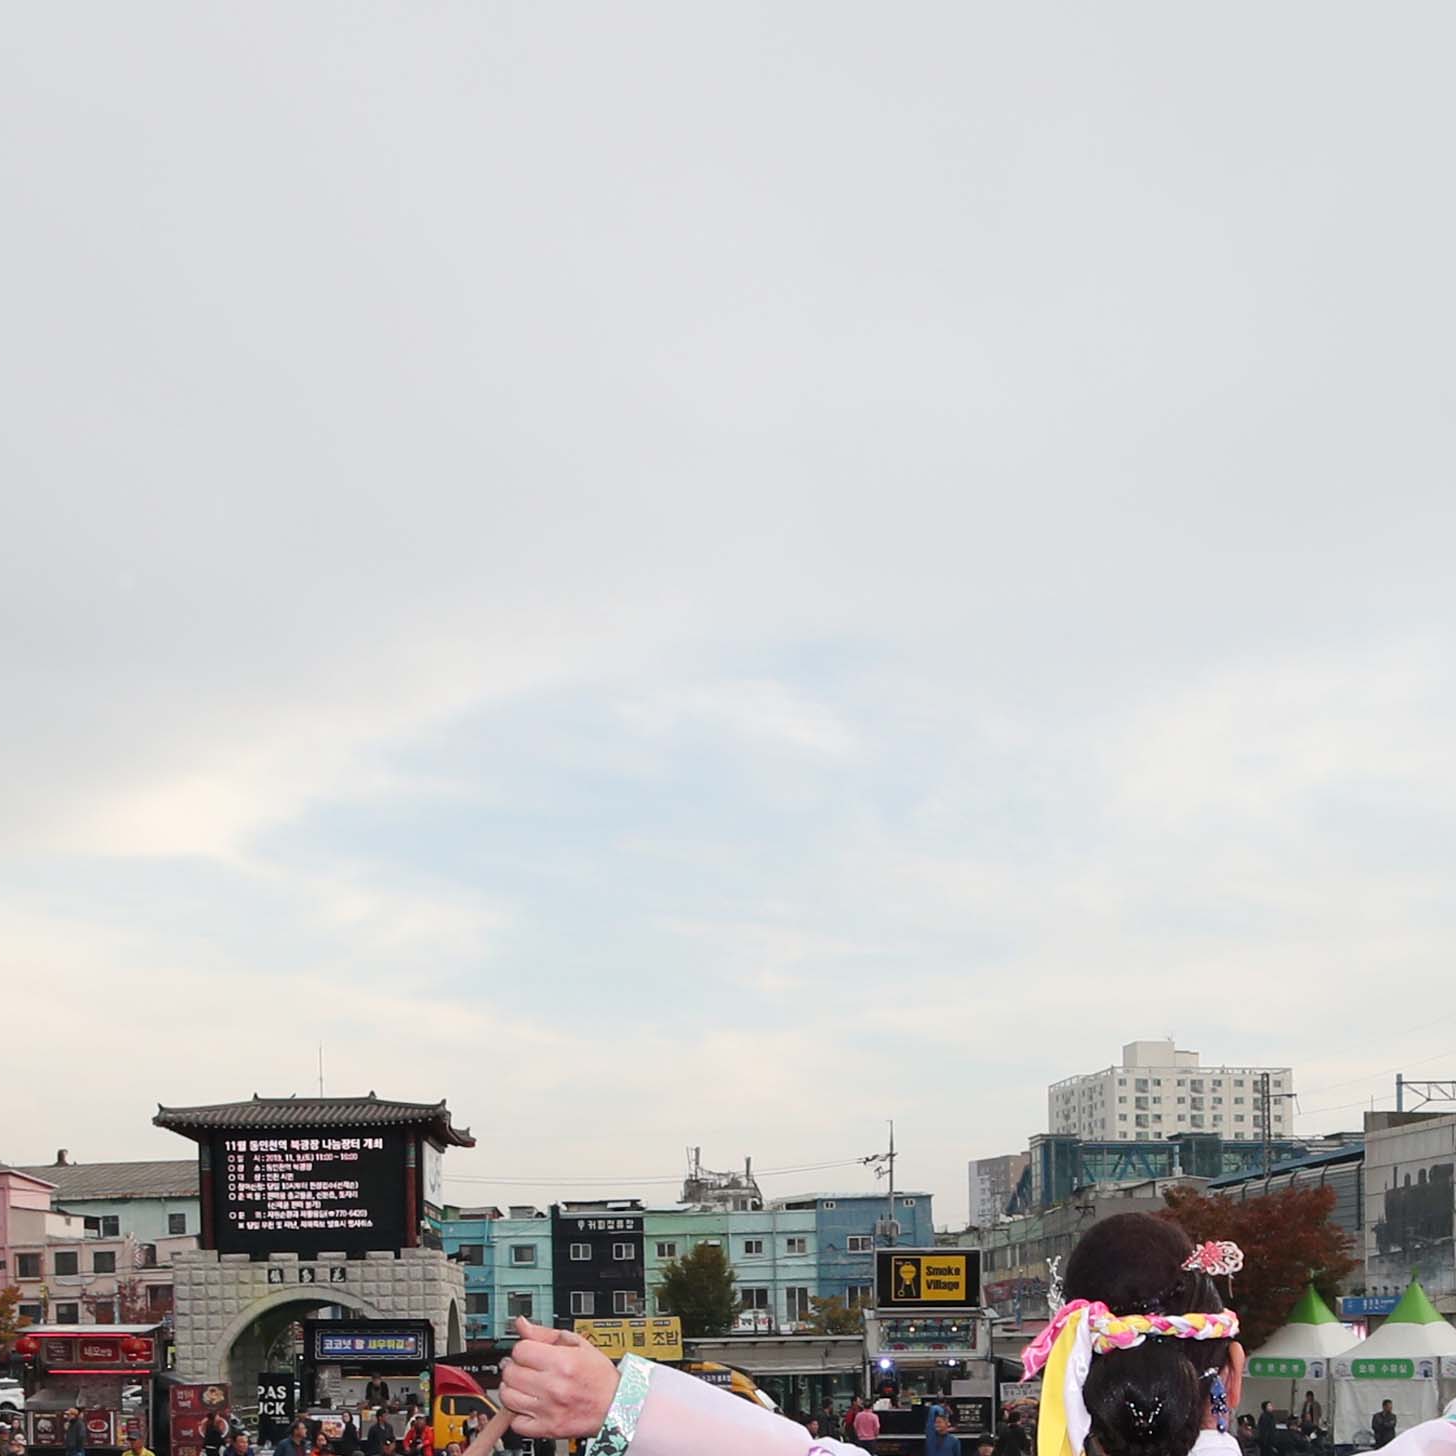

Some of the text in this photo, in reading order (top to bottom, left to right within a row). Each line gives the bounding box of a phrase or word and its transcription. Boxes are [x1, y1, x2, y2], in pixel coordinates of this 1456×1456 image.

[225, 1140, 246, 1151] 11월
[249, 1140, 287, 1151] 동인천역
[322, 1138, 360, 1150] 나눔장터
[926, 1266, 960, 1276] Smoke
[926, 1280, 960, 1291] Village
